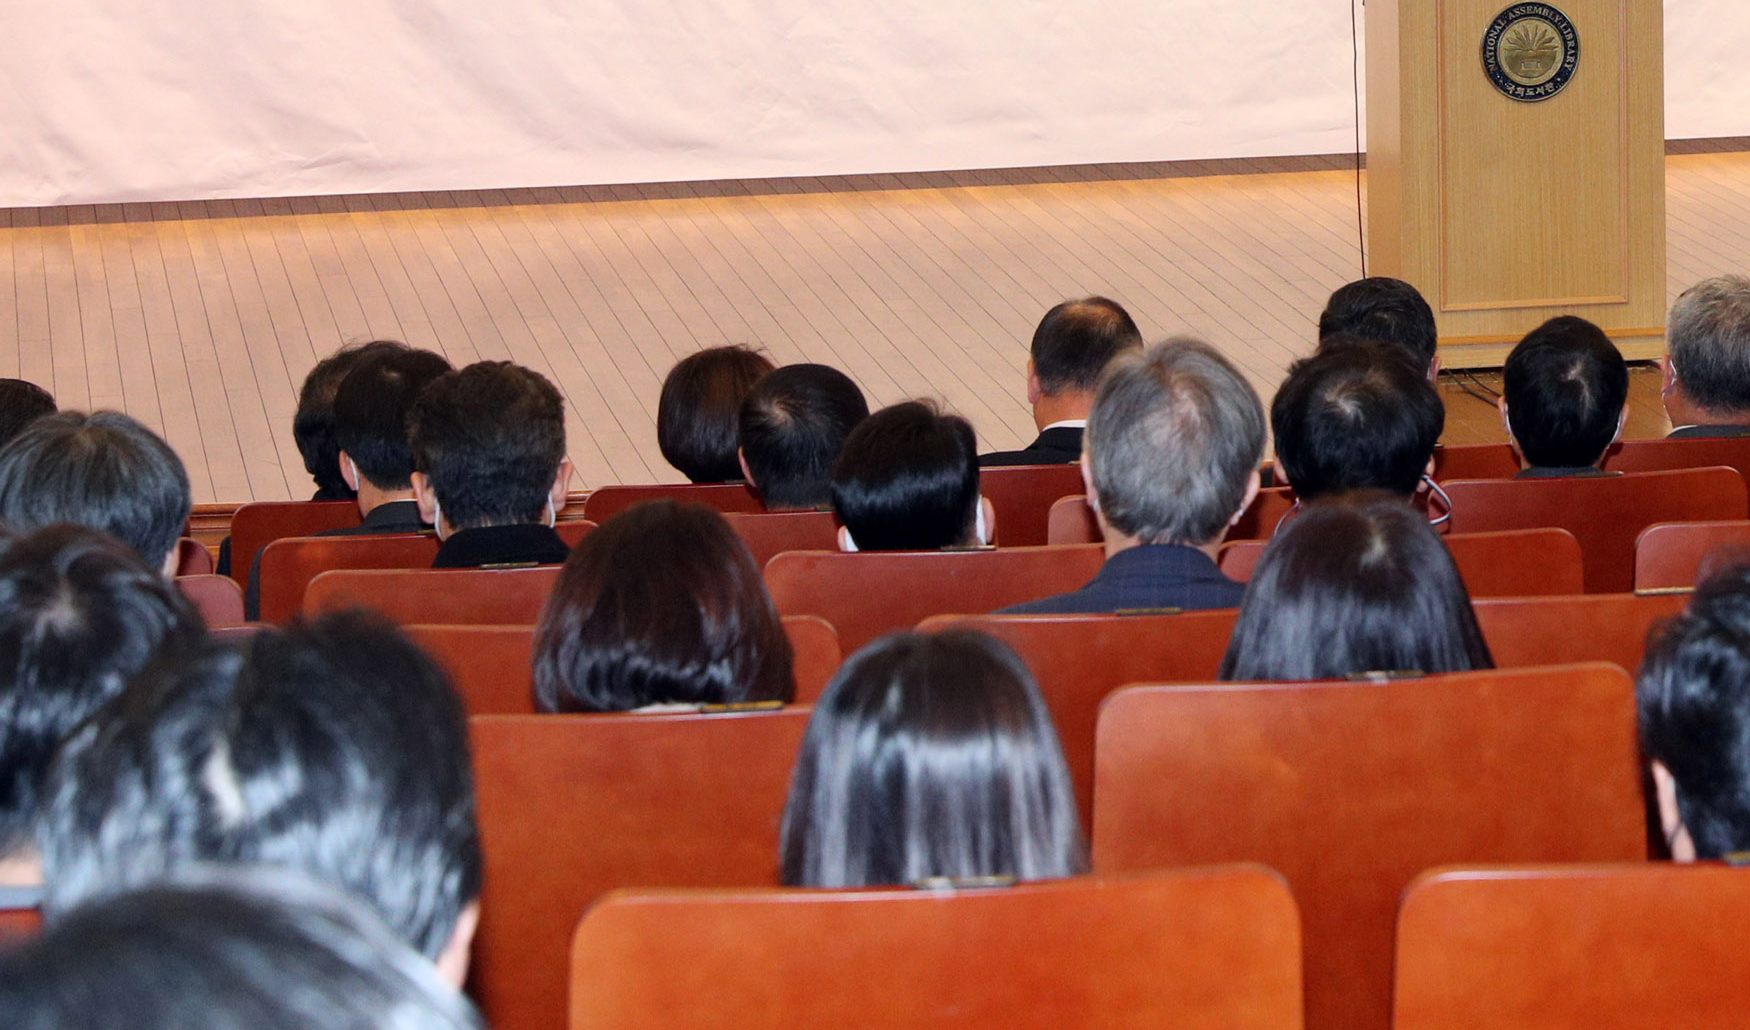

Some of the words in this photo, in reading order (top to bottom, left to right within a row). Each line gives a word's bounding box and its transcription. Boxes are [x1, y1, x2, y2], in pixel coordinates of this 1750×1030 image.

[1486, 18, 1508, 73] NATIONAL
[1508, 6, 1562, 24] ASSEMBLY
[1560, 20, 1576, 71] LIBRARY
